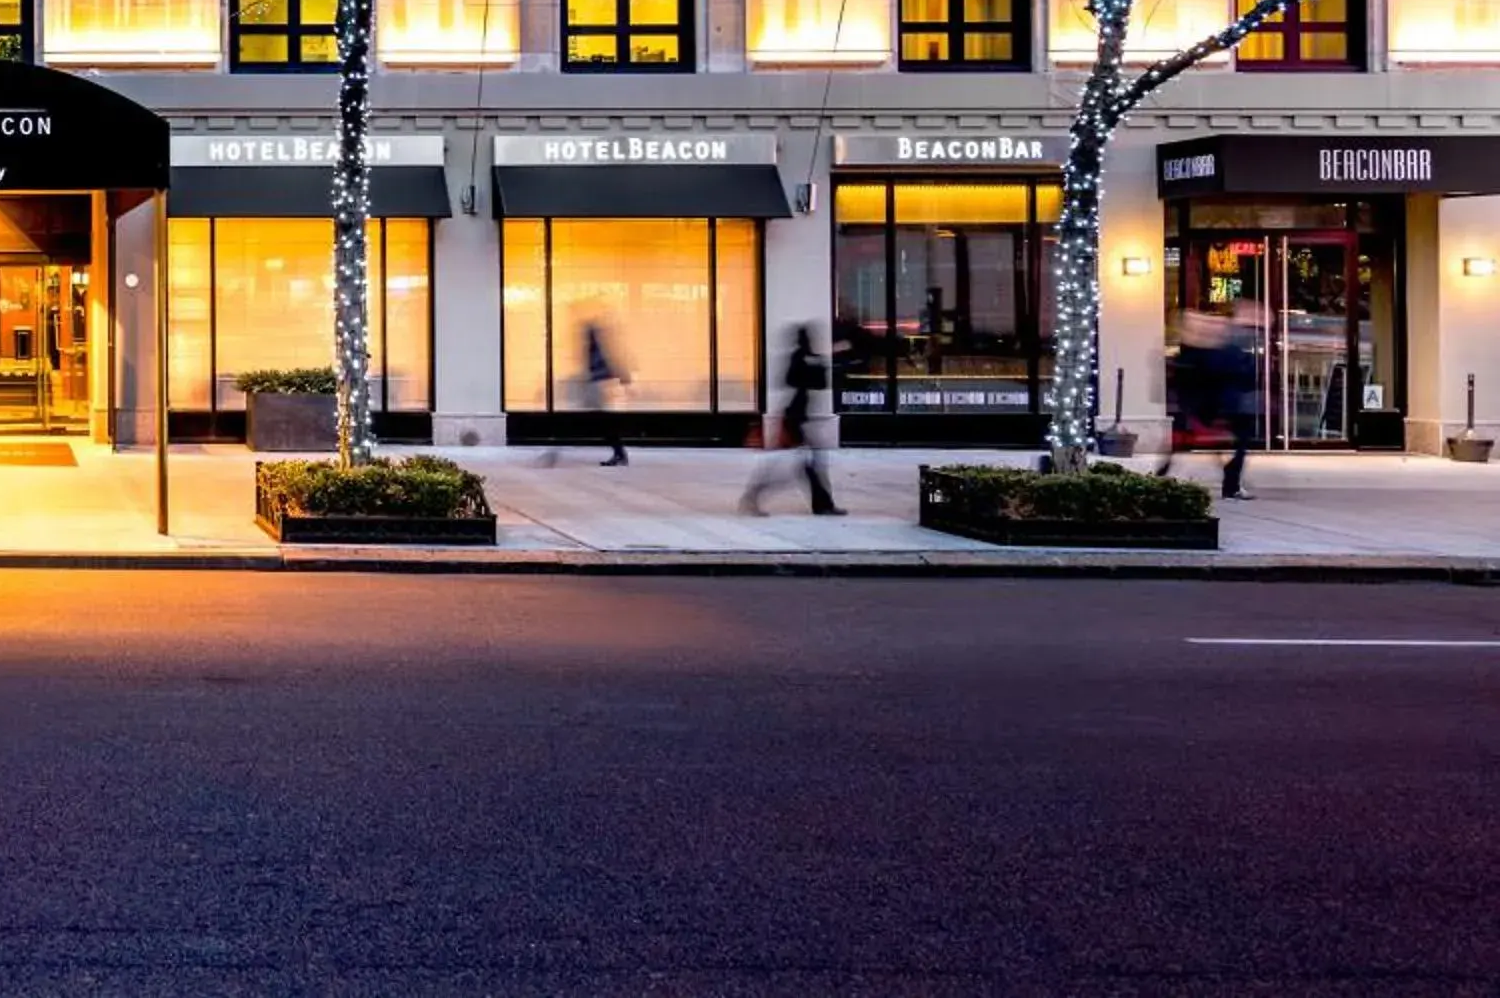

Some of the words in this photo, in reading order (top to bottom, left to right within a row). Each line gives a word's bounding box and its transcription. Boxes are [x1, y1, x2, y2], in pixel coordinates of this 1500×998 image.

[209, 137, 392, 160] HOTELBEAON
[1319, 149, 1431, 180] BEACONBAR
[1367, 389, 1379, 402] A
